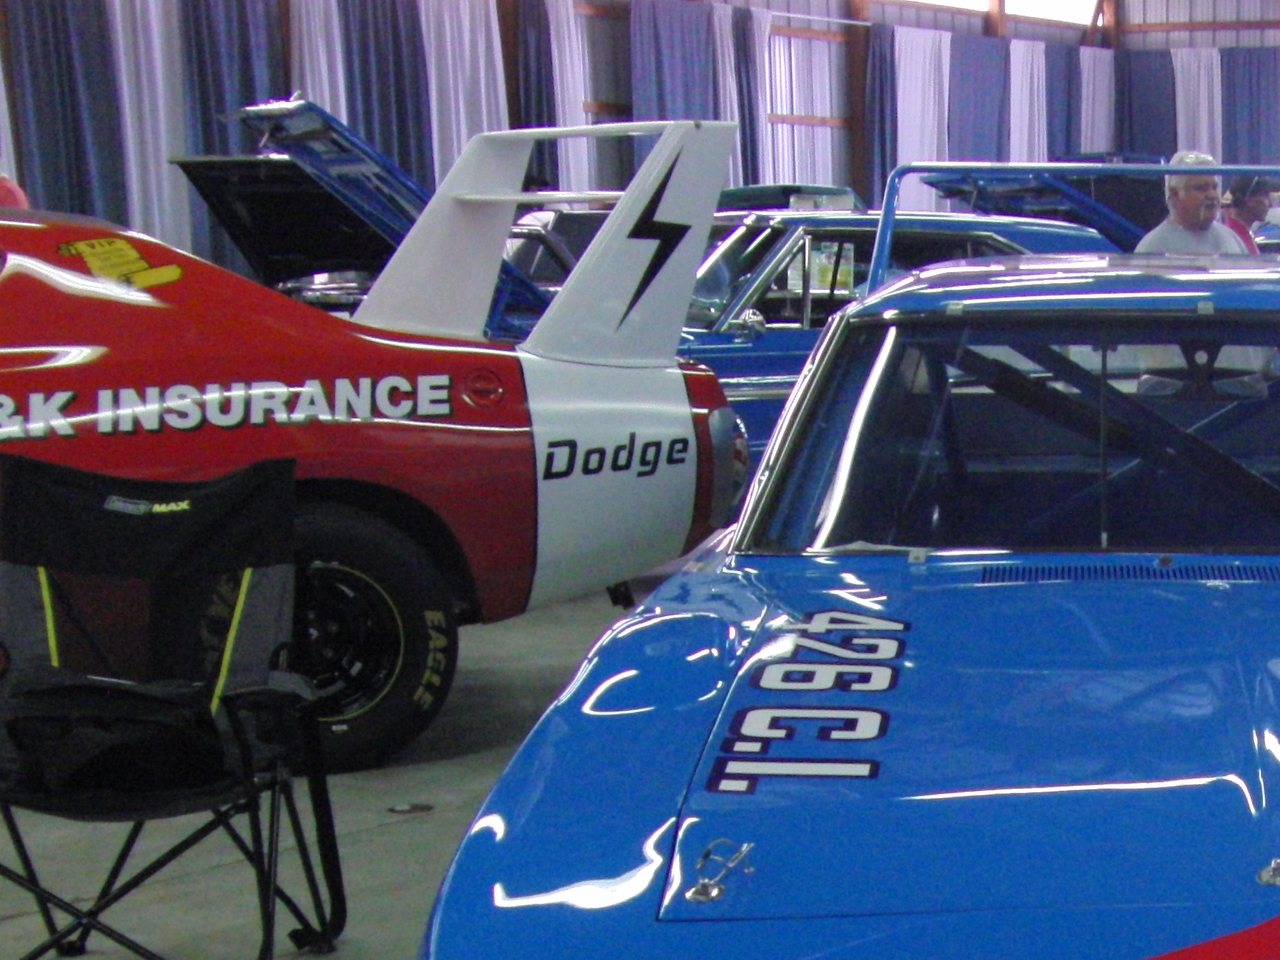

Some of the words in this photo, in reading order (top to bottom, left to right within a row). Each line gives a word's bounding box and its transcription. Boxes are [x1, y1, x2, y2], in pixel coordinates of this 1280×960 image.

[97, 374, 452, 434] INSURANCE
[543, 432, 689, 480] Dodge
[413, 610, 448, 711] EAGLE
